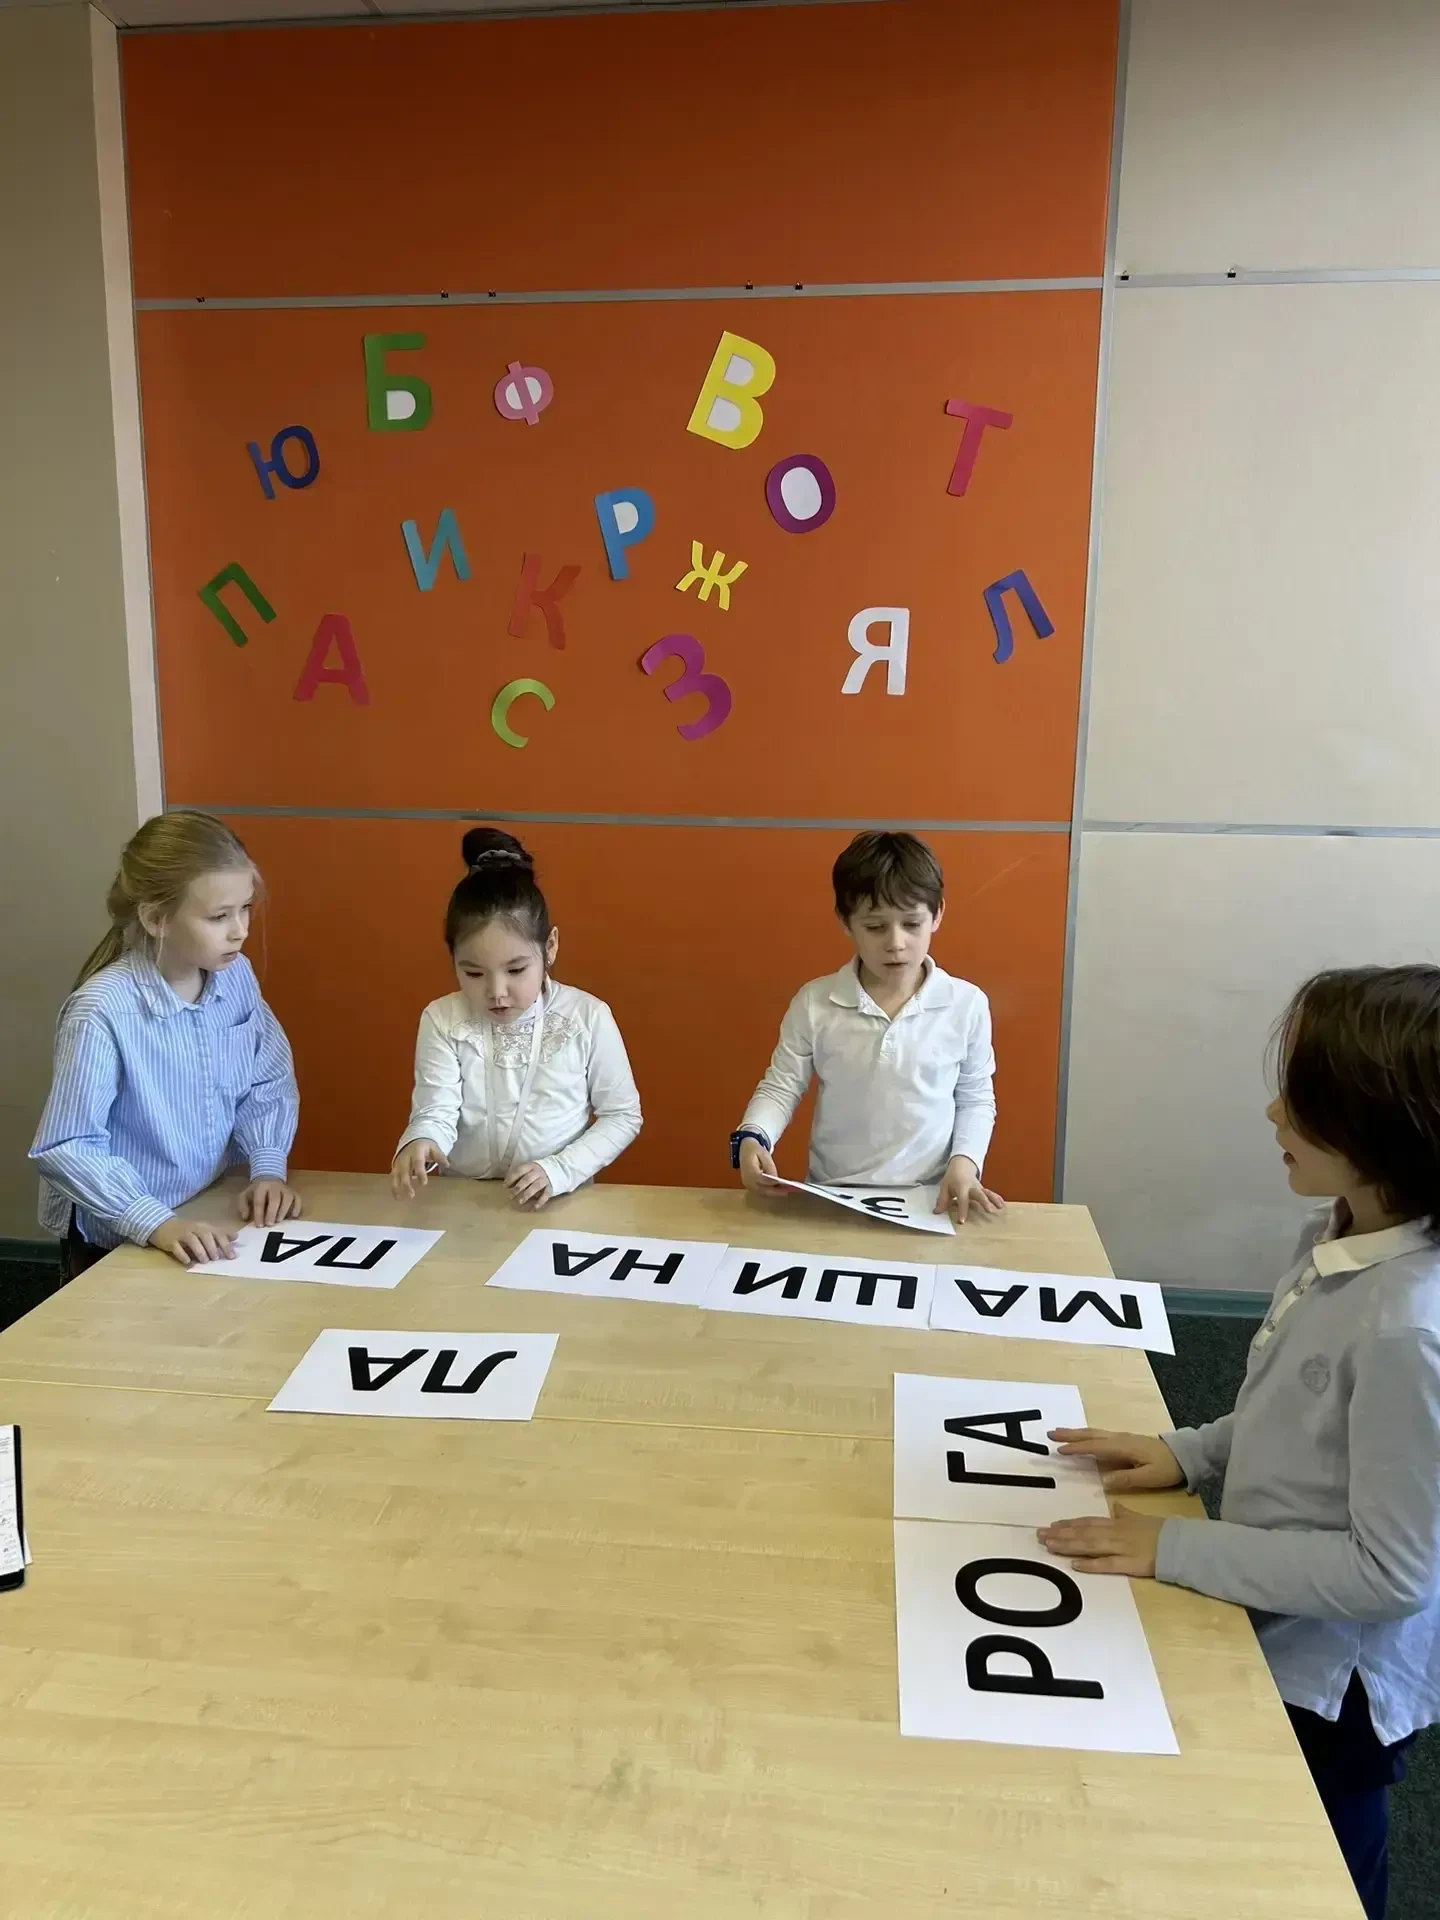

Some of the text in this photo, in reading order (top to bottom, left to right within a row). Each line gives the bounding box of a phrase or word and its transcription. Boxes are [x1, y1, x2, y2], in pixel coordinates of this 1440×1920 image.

[364, 332, 433, 431] Б
[495, 361, 554, 425] Ф
[687, 330, 776, 449] В
[247, 425, 320, 499] Ю
[944, 398, 1013, 496] Т
[594, 487, 655, 580] Р
[766, 453, 836, 533] О
[401, 508, 471, 591] И
[675, 540, 748, 611] Ж
[199, 561, 277, 647] П
[508, 552, 581, 649] К
[983, 569, 1055, 664] Л
[293, 613, 370, 705] А
[641, 634, 732, 740] З
[841, 606, 910, 695] Я
[491, 678, 555, 748] С
[260, 1231, 397, 1270] ПА
[552, 1243, 1143, 1329] МА ШИ НА
[348, 1347, 518, 1394] ЛА
[944, 1409, 1104, 1700] РО ГА
